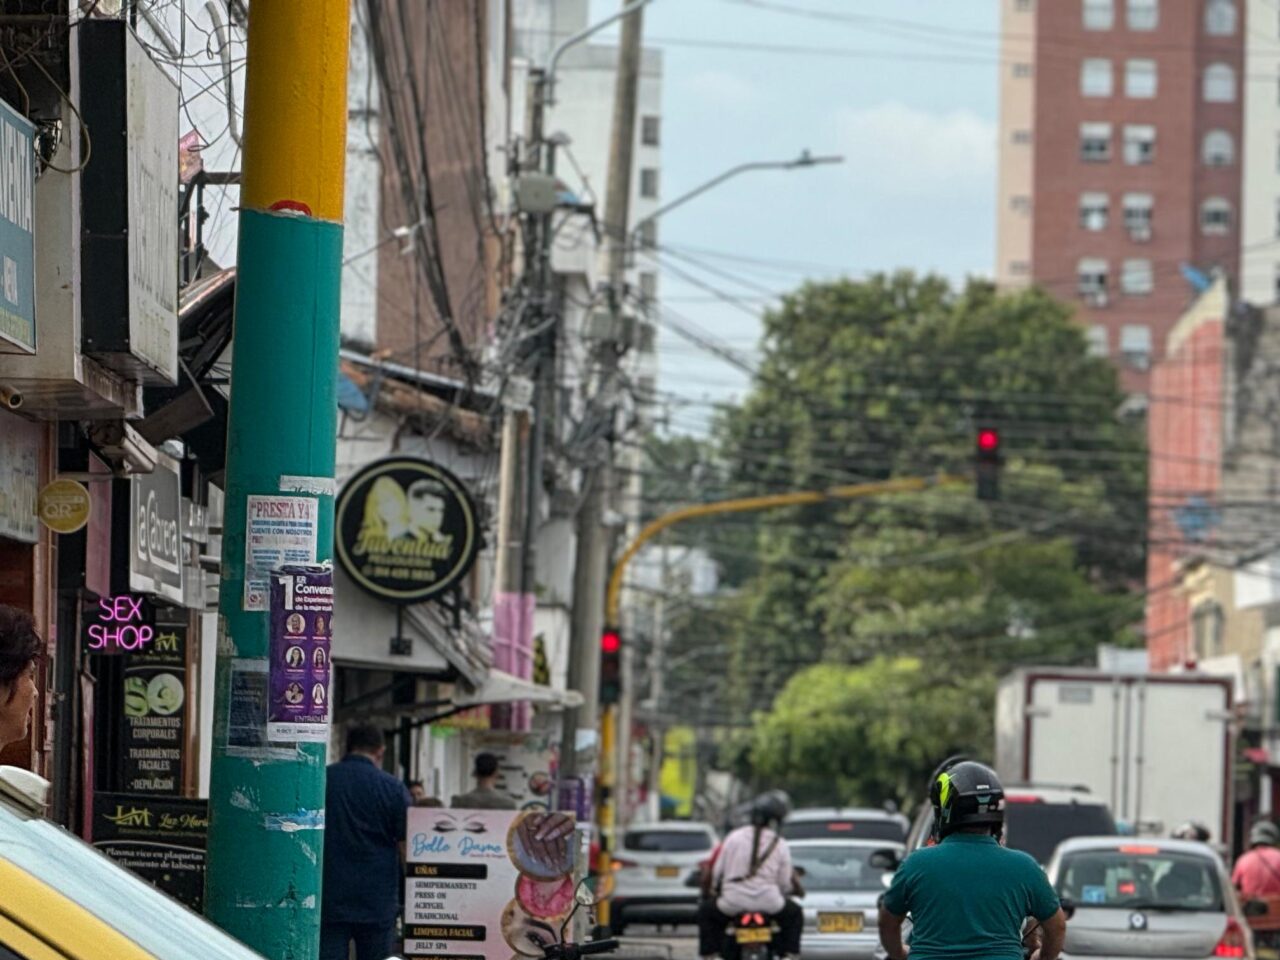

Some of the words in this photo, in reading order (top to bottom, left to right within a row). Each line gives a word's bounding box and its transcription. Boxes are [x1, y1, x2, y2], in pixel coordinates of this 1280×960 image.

[99, 596, 143, 621] SEX
[88, 625, 153, 650] SHOP
[130, 717, 181, 727] TRATAMIENTOS
[133, 729, 177, 739] CORPORALES
[130, 749, 180, 759] TRATAMIENTOS
[138, 760, 170, 770] FACIALES
[106, 847, 134, 857] Plasma
[415, 866, 438, 875] UÑAS
[415, 882, 477, 890] SEMIPERMANENTE
[414, 902, 445, 910] ACRYGEL
[414, 912, 459, 921] TRADICIONAL
[413, 928, 448, 937] LIMPIEZA
[450, 929, 475, 937] FACIAL
[415, 942, 434, 950] JELLY
[435, 942, 447, 950] SPA
